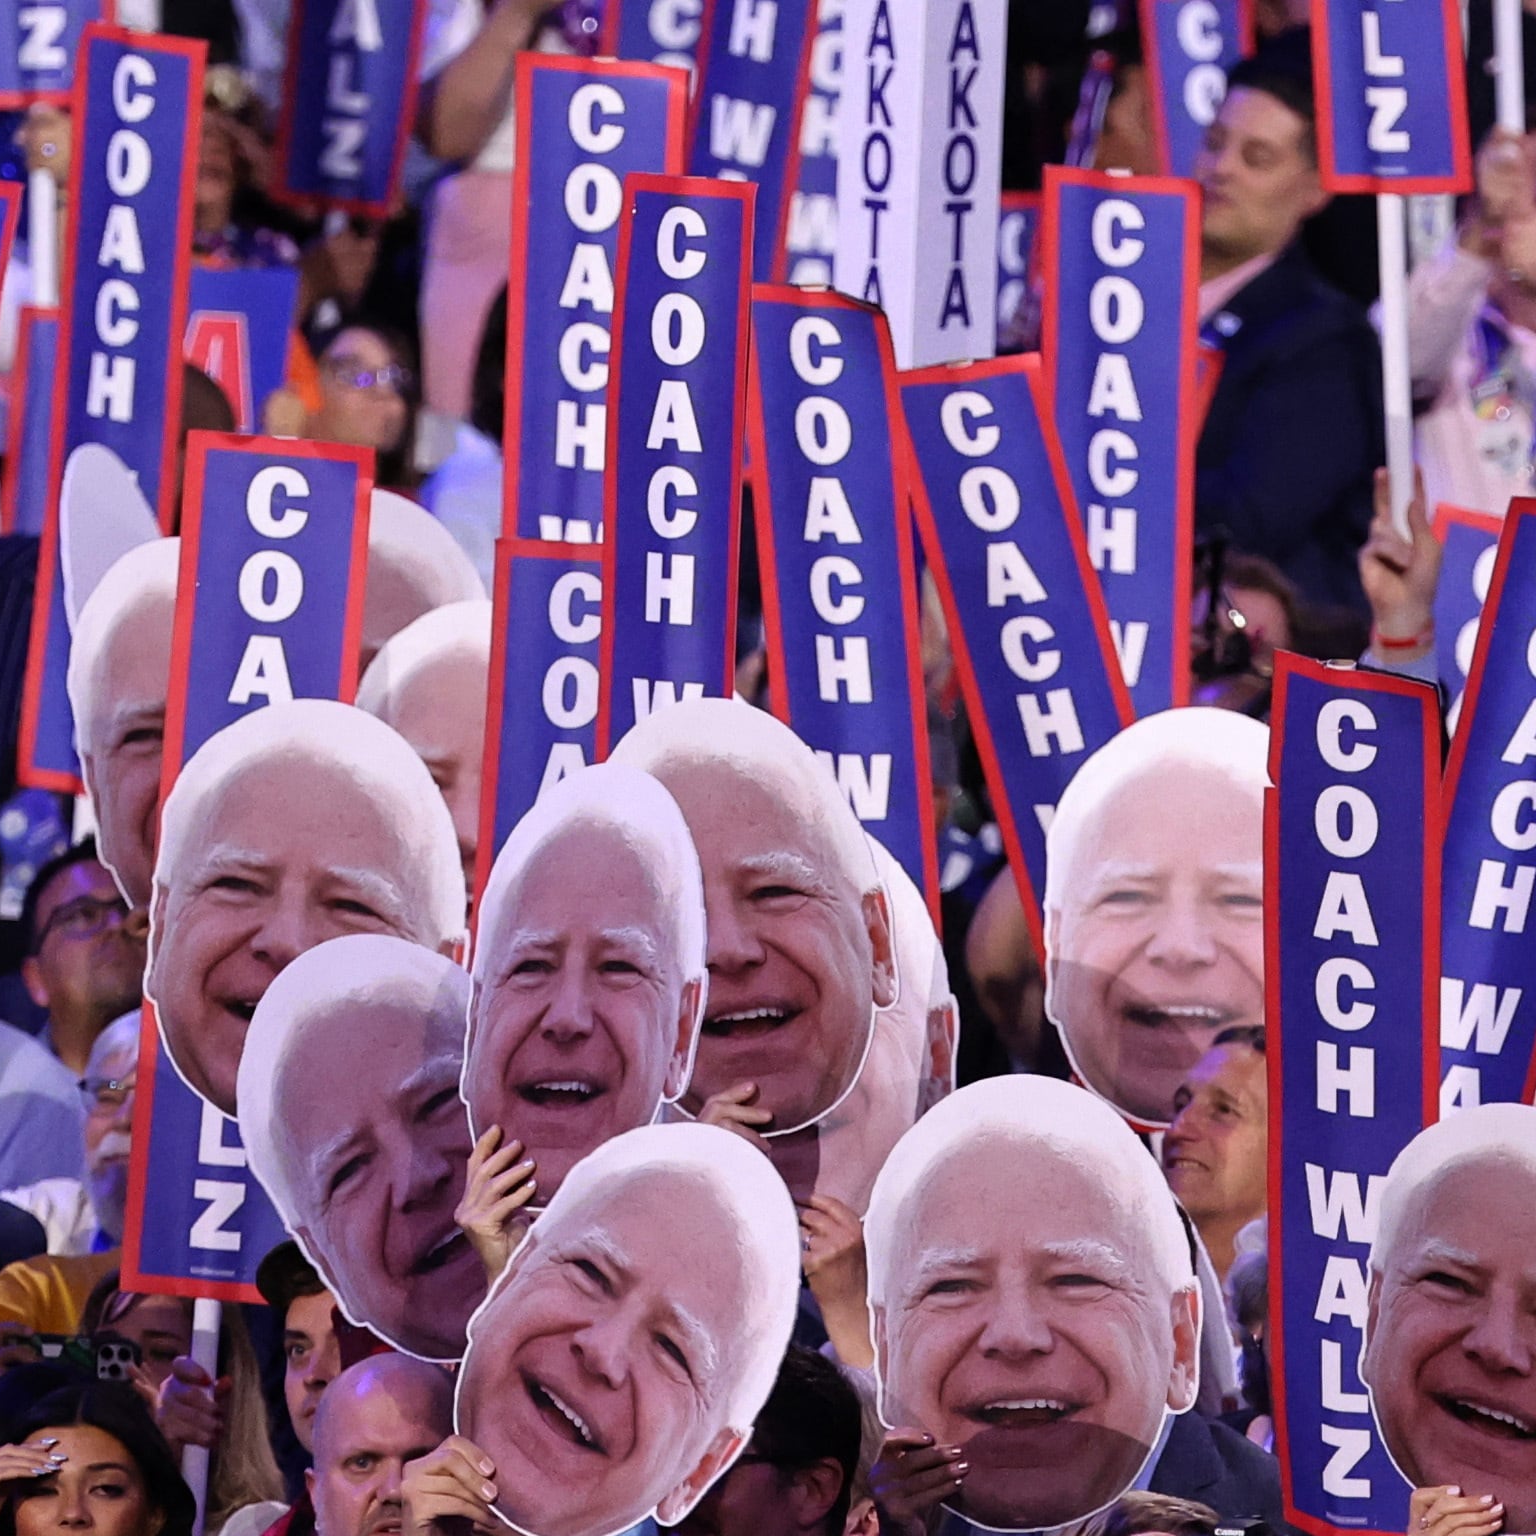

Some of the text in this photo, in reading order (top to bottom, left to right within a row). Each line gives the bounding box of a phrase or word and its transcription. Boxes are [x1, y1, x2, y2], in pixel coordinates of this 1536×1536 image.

[87, 54, 156, 423] COACH
[556, 83, 625, 471] COACH
[644, 206, 708, 626] COACH
[1087, 198, 1146, 575] COACH
[789, 315, 872, 704] COACH
[940, 390, 1085, 757] COACH
[1305, 698, 1389, 1499] COACH WALZ
[1214, 1527, 1245, 1536] Canon
